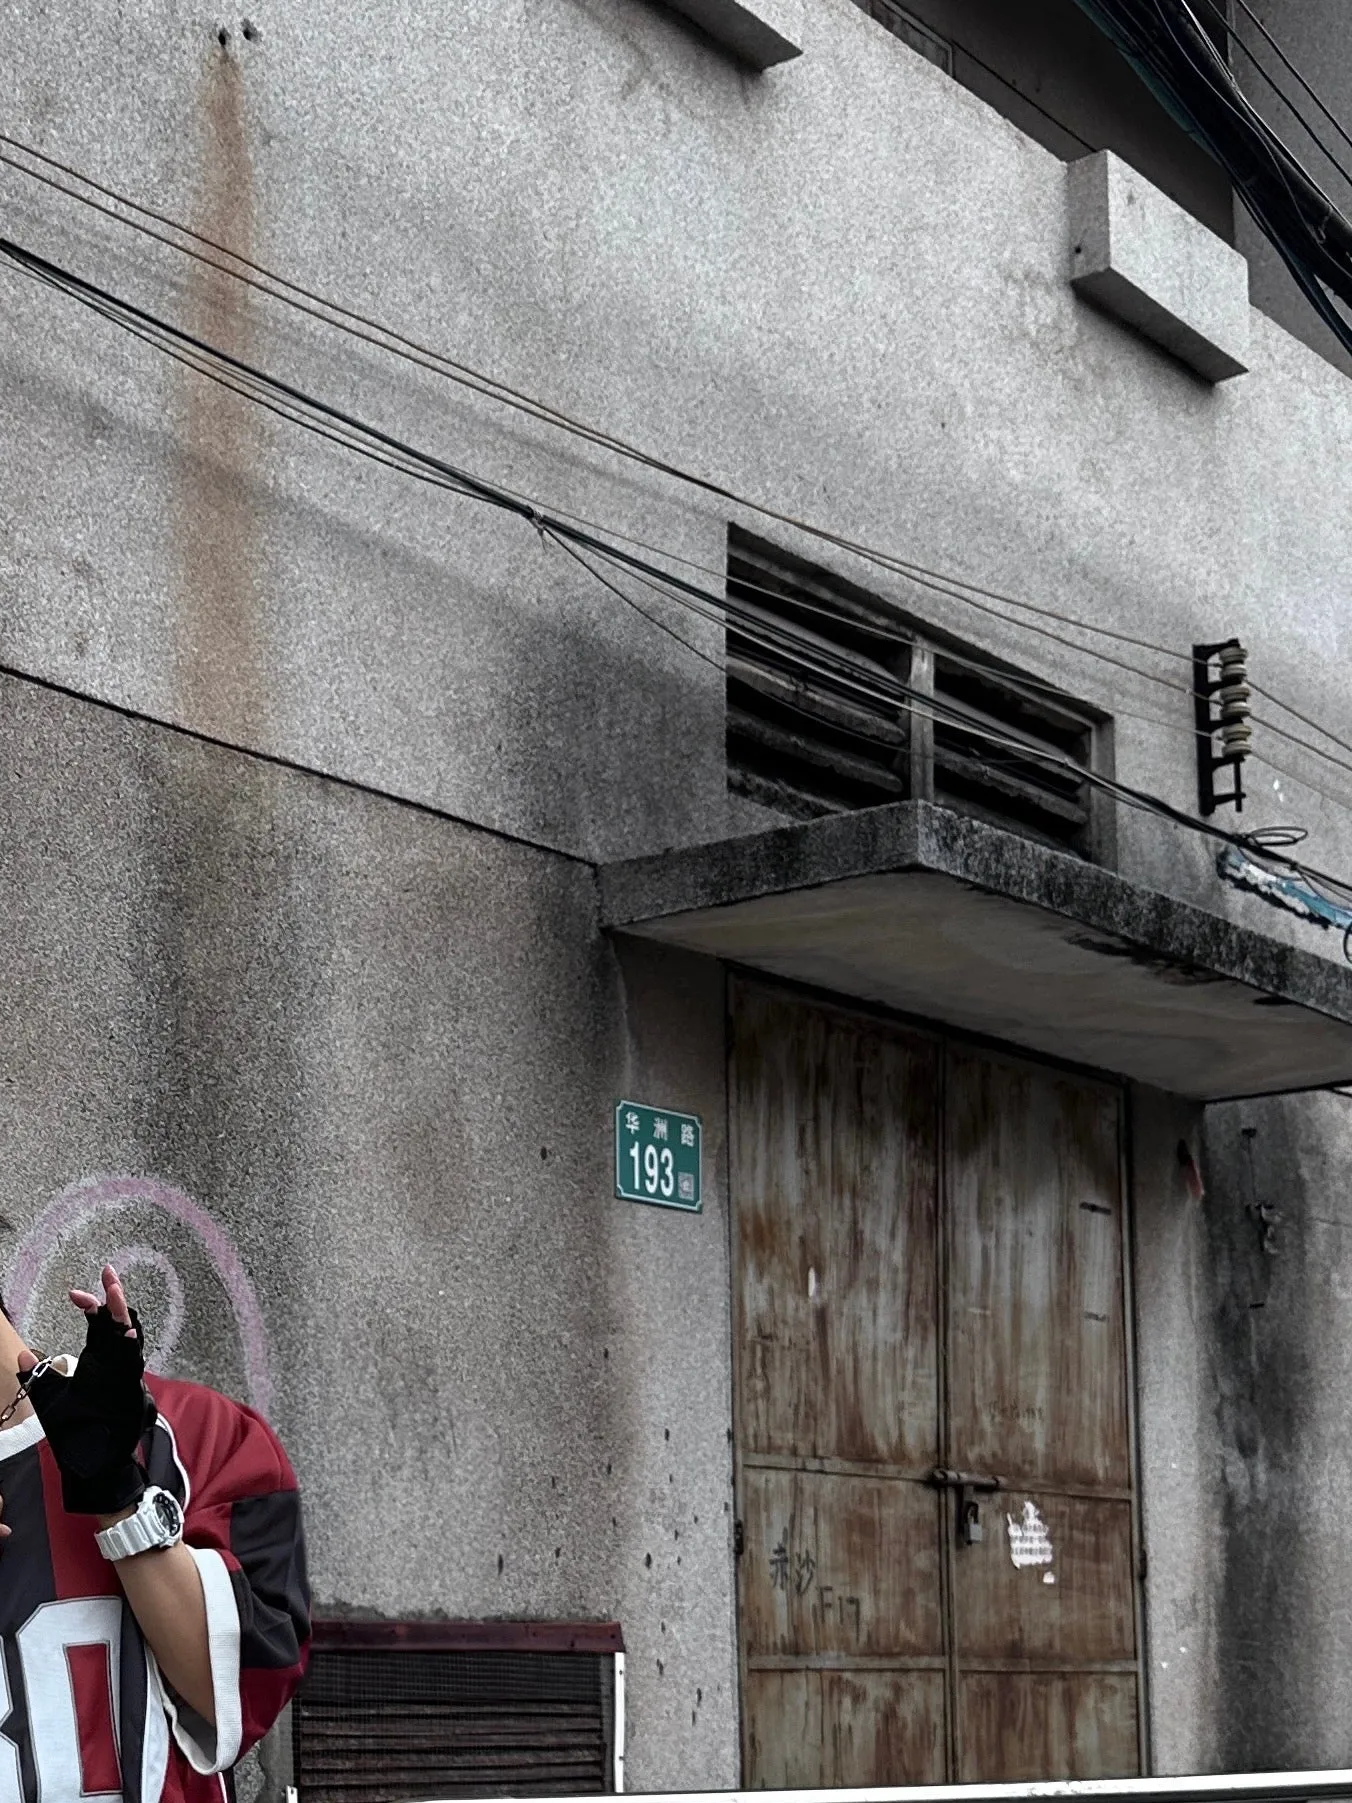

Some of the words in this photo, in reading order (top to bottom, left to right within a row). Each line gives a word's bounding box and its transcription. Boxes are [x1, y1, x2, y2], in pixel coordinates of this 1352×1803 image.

[625, 1111, 695, 1148] 华洲路
[629, 1141, 674, 1197] 193
